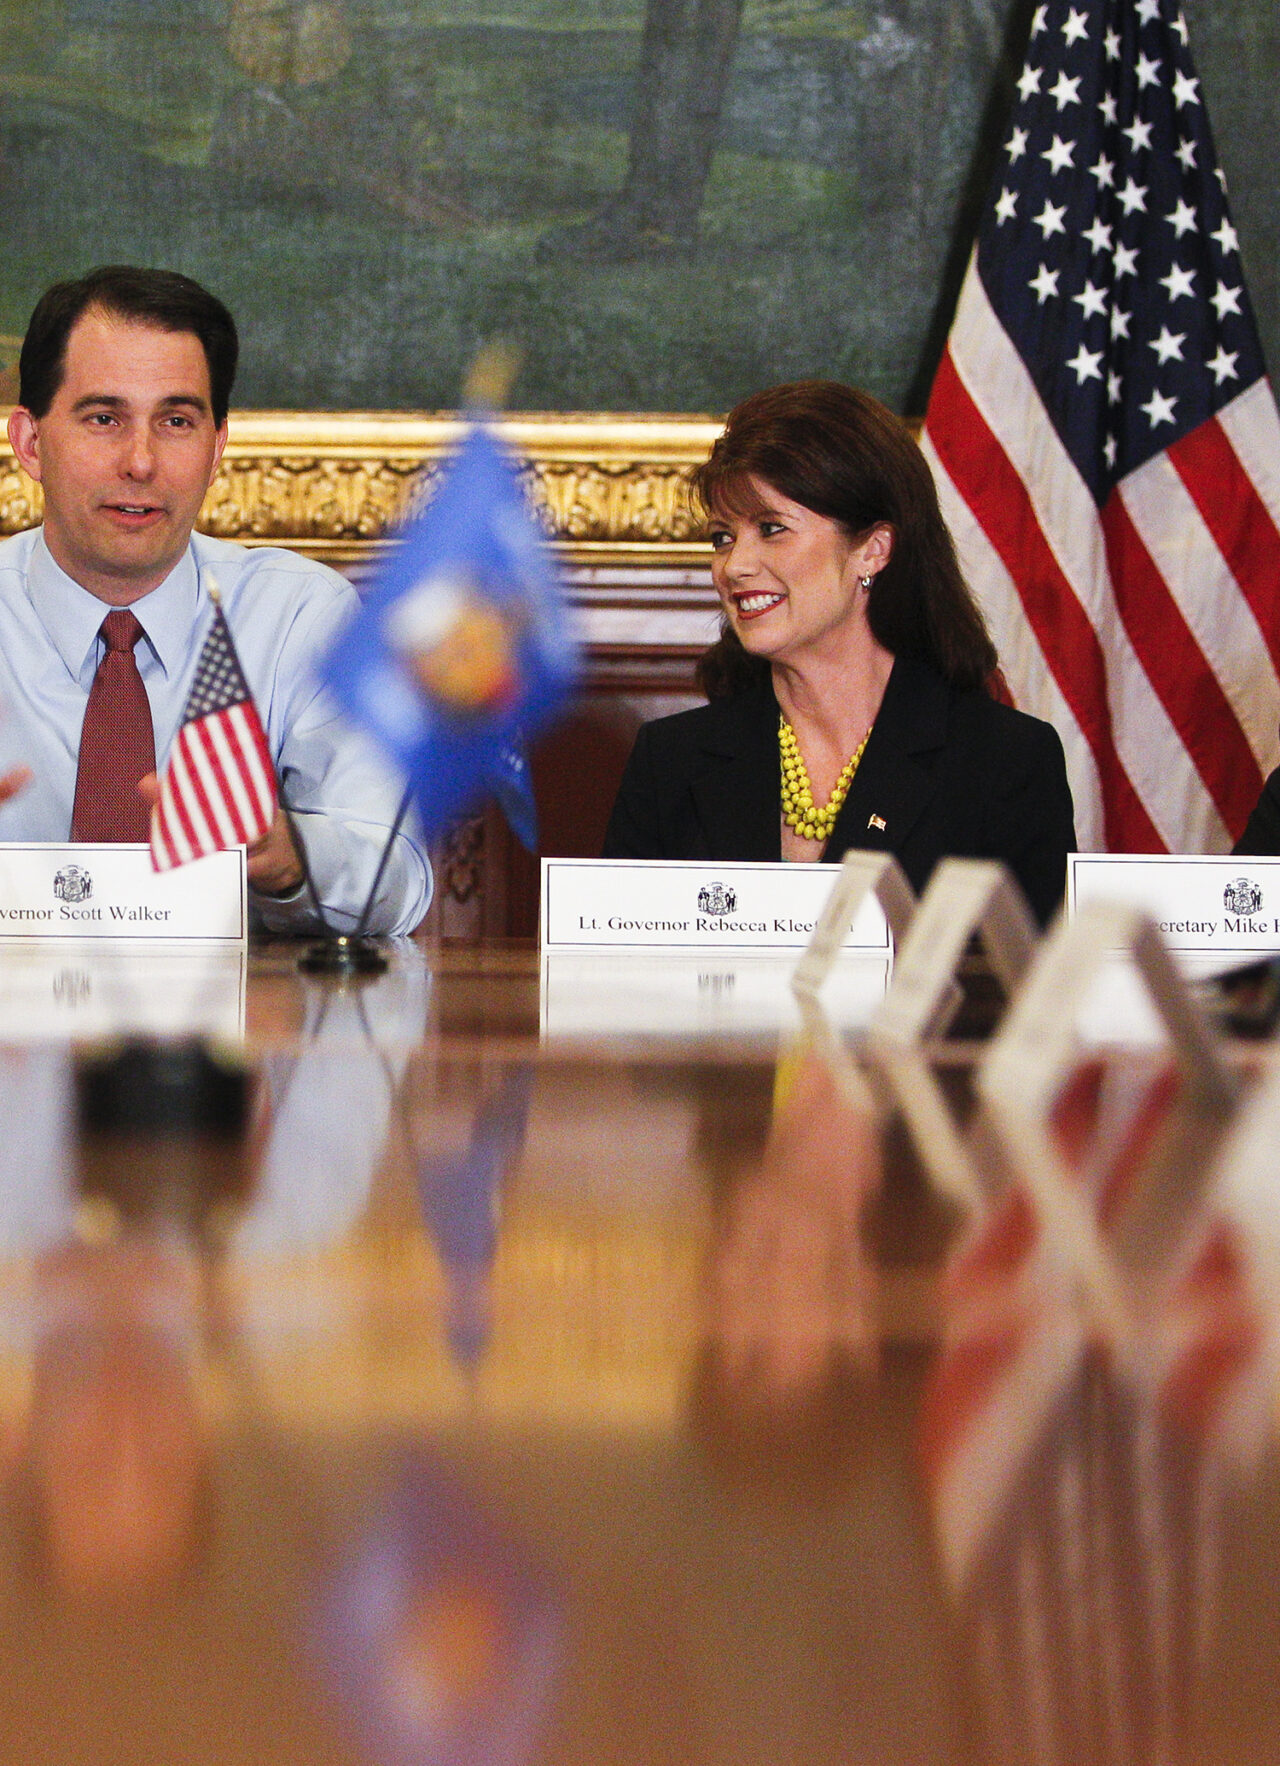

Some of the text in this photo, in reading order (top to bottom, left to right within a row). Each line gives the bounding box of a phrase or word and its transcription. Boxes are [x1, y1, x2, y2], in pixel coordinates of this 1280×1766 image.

[59, 906, 103, 920] Scott
[109, 906, 171, 921] Walker
[579, 917, 602, 930] Lt.
[608, 917, 690, 931] Governor
[696, 918, 767, 932] Rebecca
[1159, 920, 1218, 936] cretary
[1224, 918, 1268, 933] Mike
